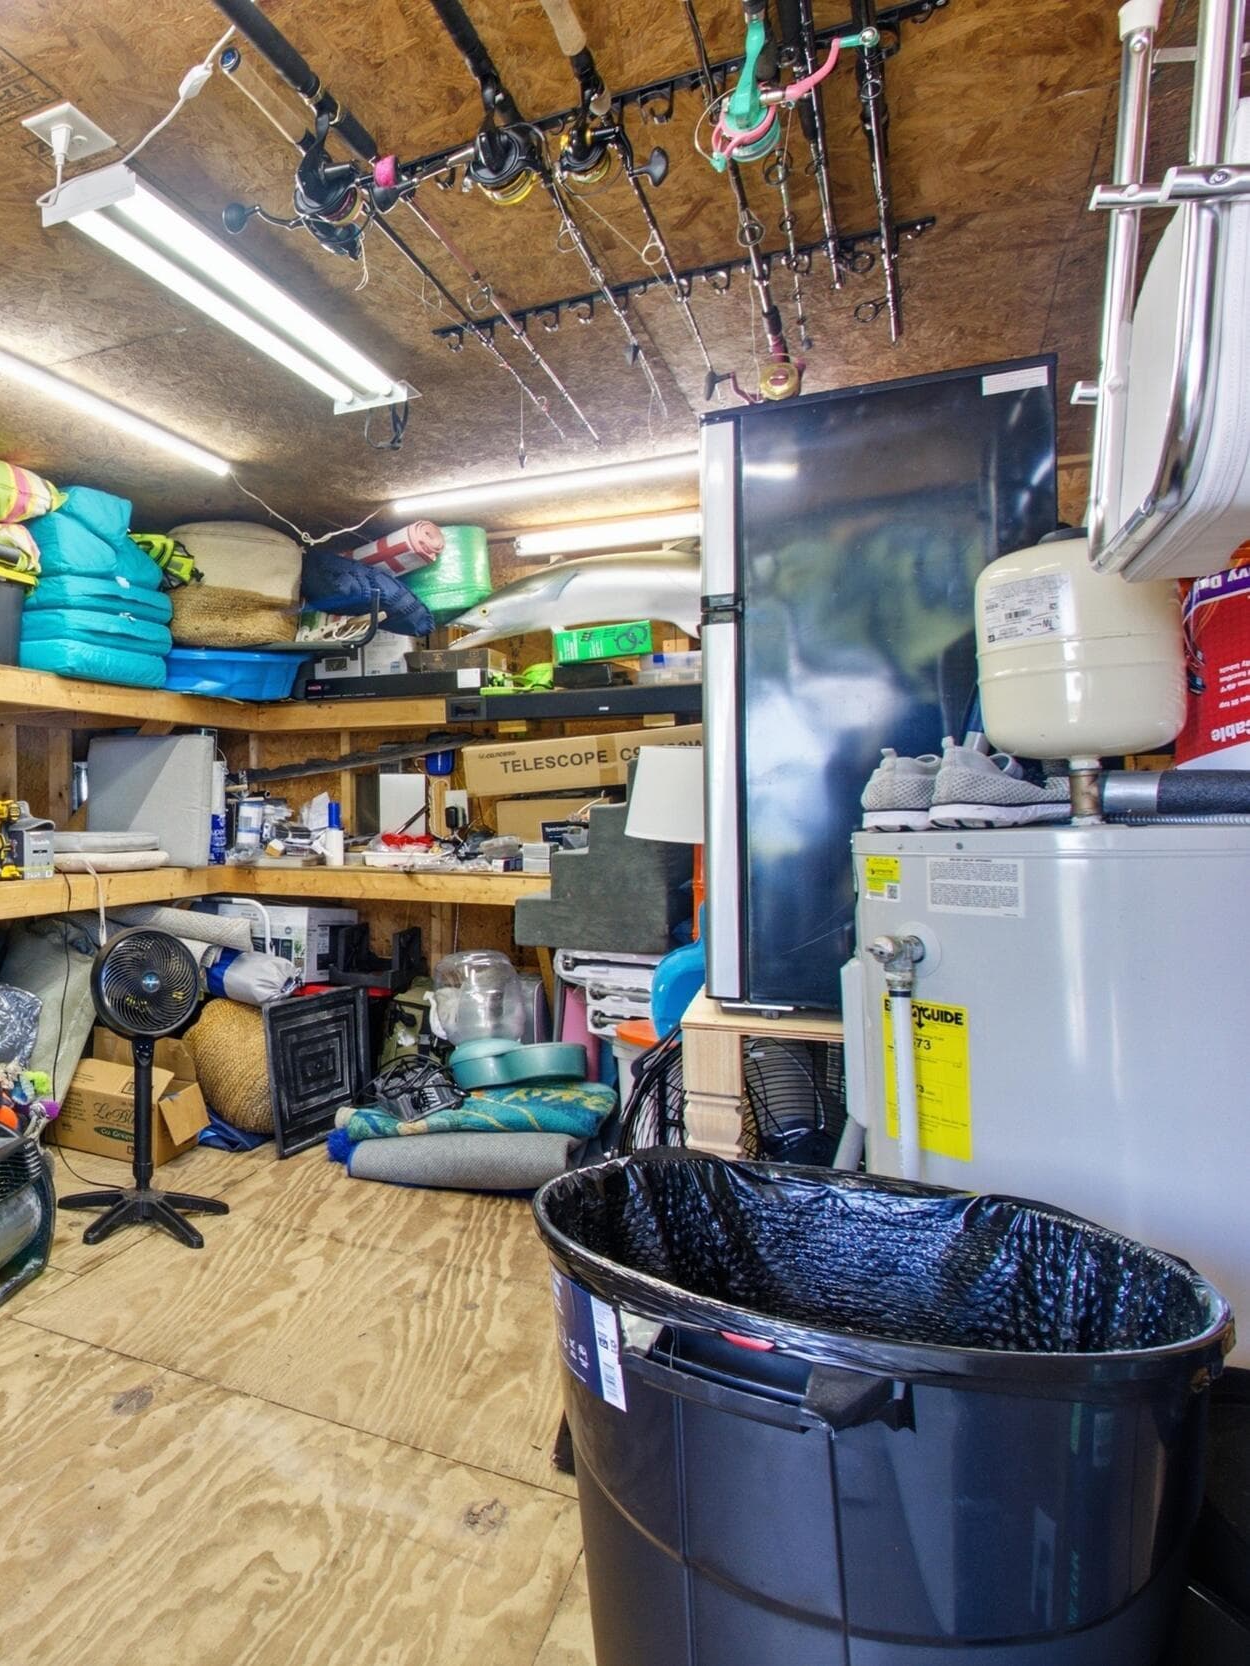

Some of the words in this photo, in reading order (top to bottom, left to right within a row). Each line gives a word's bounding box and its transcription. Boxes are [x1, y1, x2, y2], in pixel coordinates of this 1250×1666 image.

[500, 749, 608, 774] TELESCOPE
[884, 999, 964, 1027] EGYGUIDE
[93, 1102, 135, 1125] LeBl
[113, 1129, 135, 1140] Green
